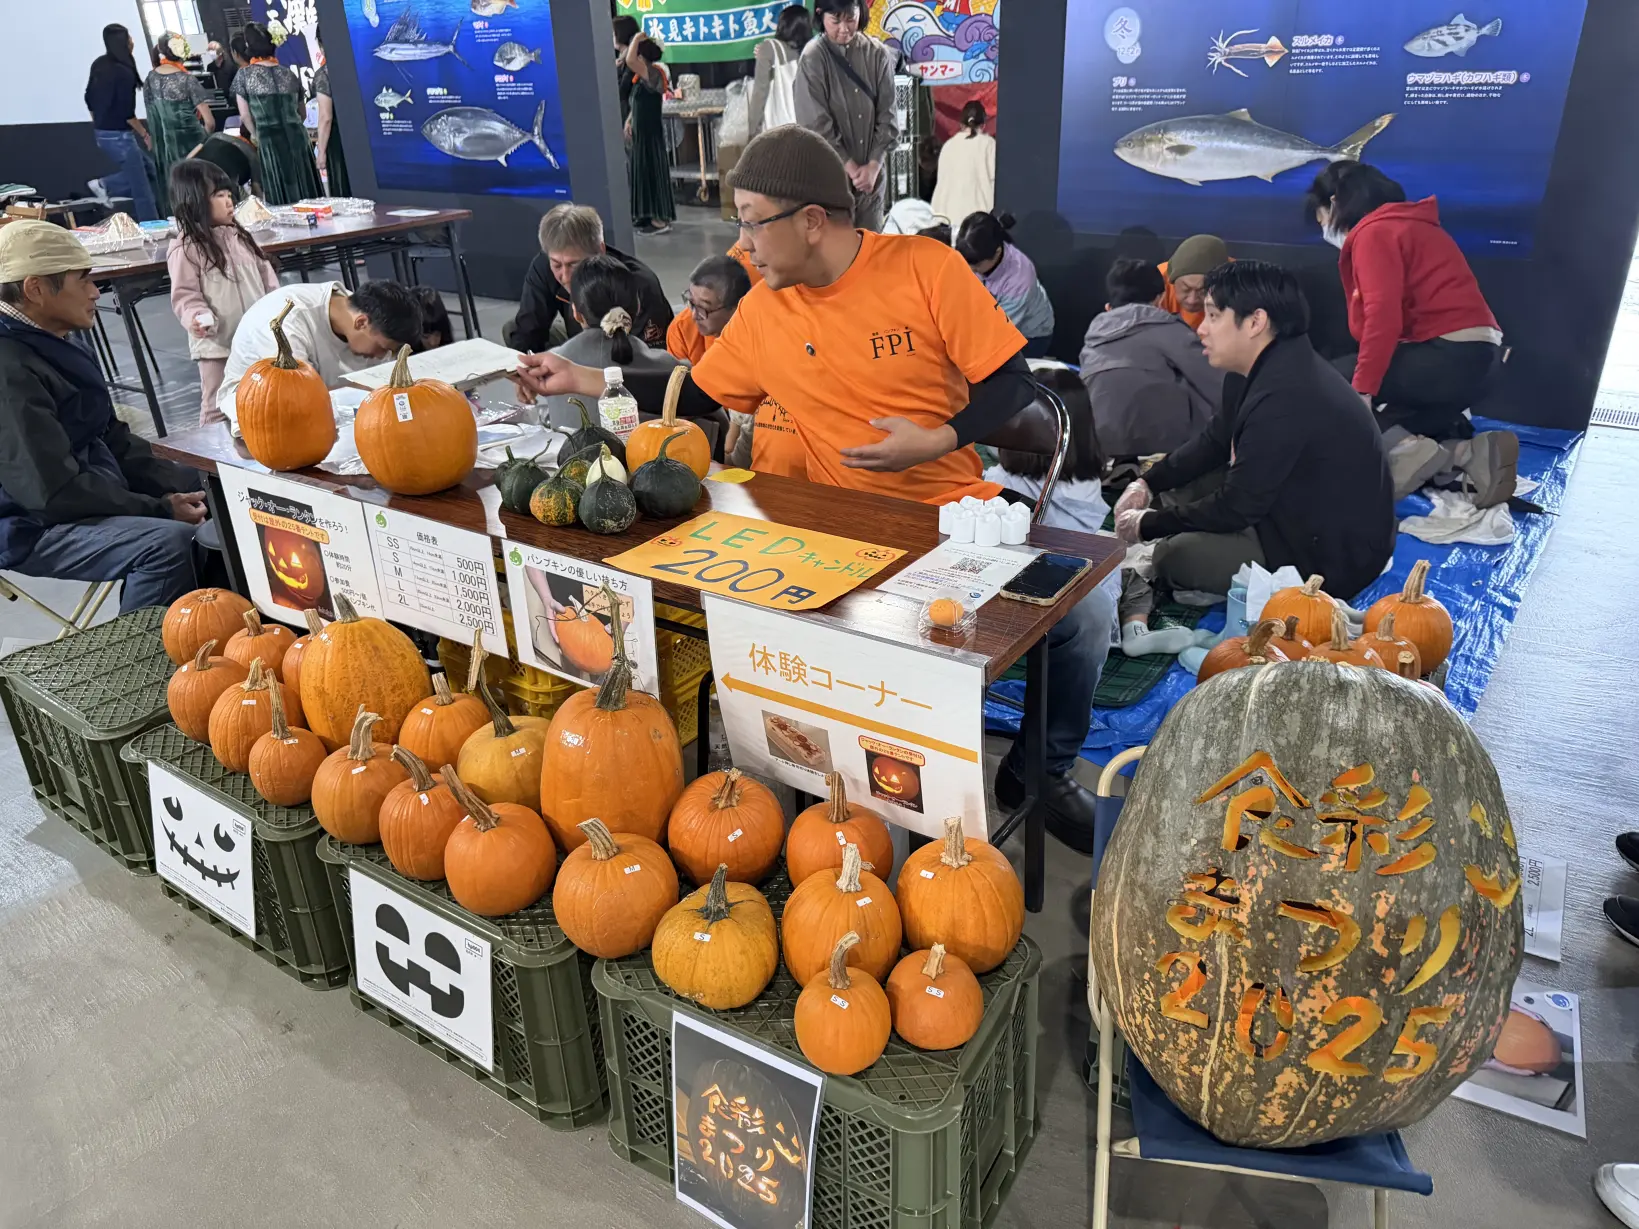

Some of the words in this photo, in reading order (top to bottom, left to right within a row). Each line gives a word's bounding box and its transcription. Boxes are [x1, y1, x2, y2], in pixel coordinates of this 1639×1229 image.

[649, 2, 793, 42] 氷見キトキト魚大
[1112, 17, 1132, 39] 冬
[1292, 35, 1333, 46] スルメイカ
[919, 64, 954, 76] ヤンマー
[869, 330, 916, 360] FPI
[386, 536, 400, 550] SS
[456, 557, 486, 576] 500円
[416, 531, 439, 547] 価格表
[392, 552, 400, 563] S
[452, 570, 488, 591] 1,000円
[394, 566, 403, 578] M
[454, 584, 490, 606] 1,500円
[651, 549, 817, 605] 200円
[397, 580, 405, 592] L
[456, 599, 493, 620] 2,000円
[398, 593, 410, 606] 2L
[459, 613, 496, 635] 2,500円
[748, 642, 933, 711] 体験コーナー
[1526, 859, 1543, 887] 2,500円
[1155, 951, 1456, 1083] 2025
